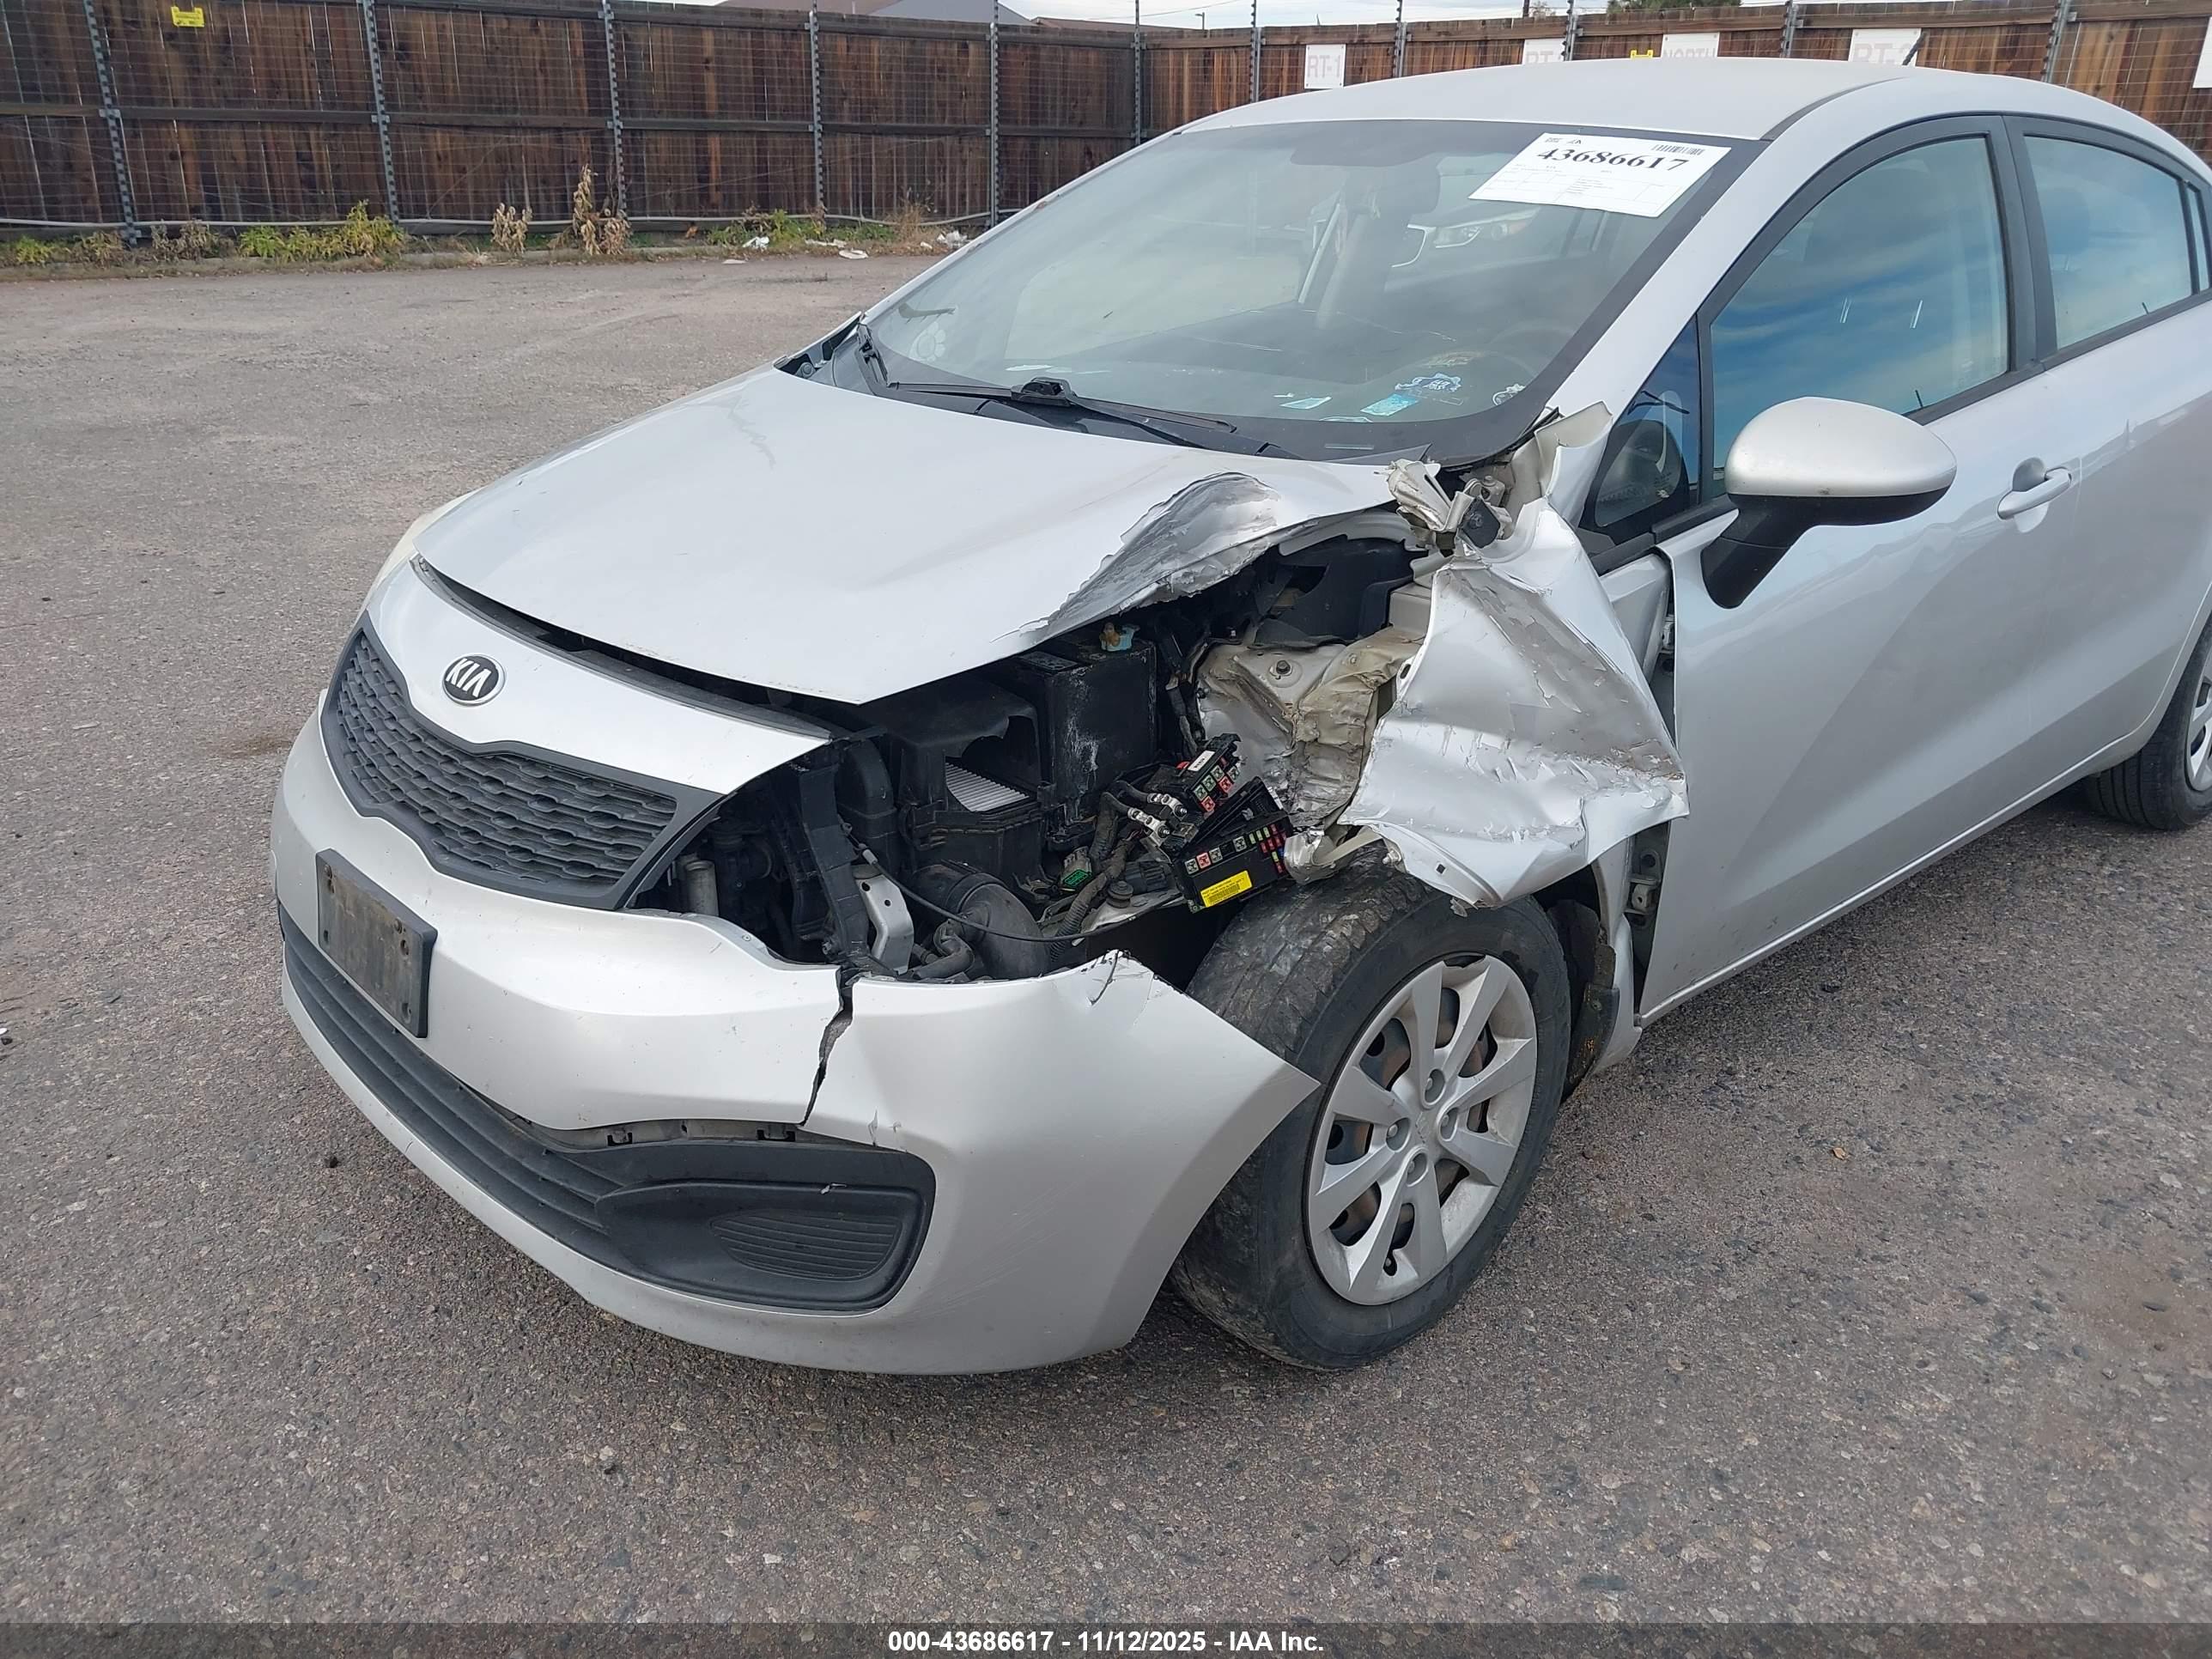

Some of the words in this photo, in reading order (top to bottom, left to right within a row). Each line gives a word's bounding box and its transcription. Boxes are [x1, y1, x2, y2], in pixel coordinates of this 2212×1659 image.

[1307, 54, 1340, 78] RT-1
[1536, 148, 1691, 172] 43686617
[445, 657, 492, 698] KIA
